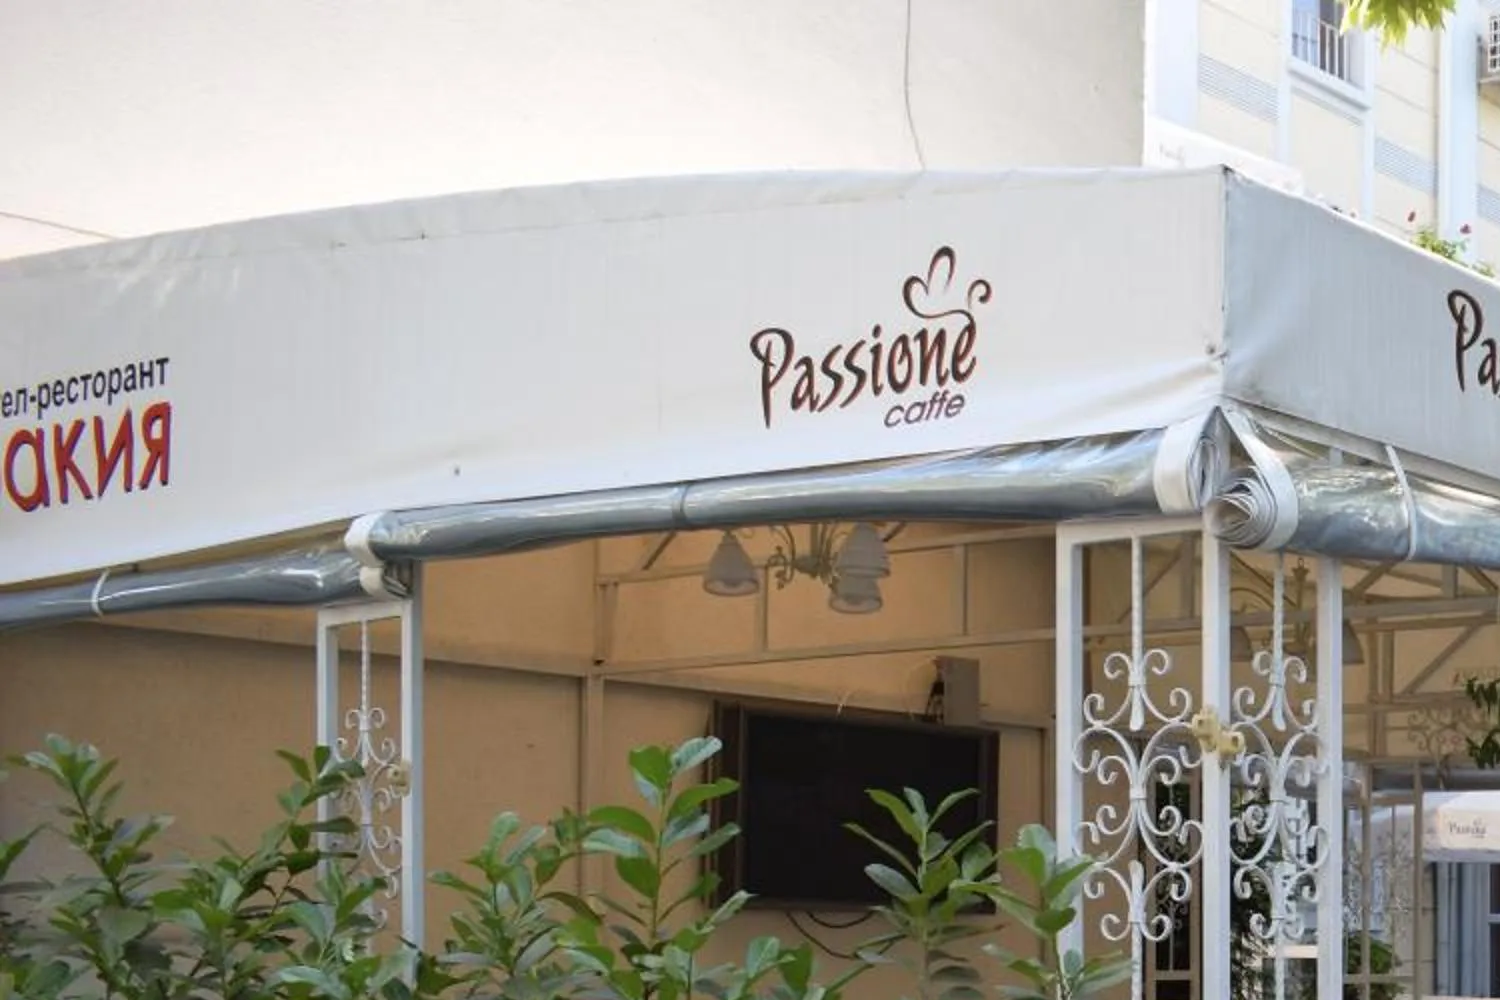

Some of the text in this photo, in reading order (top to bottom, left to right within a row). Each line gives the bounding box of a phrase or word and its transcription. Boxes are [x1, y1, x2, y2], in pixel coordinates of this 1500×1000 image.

[0, 357, 170, 420] ел-ресторант
[750, 313, 977, 429] Passione
[884, 390, 966, 428] caffe
